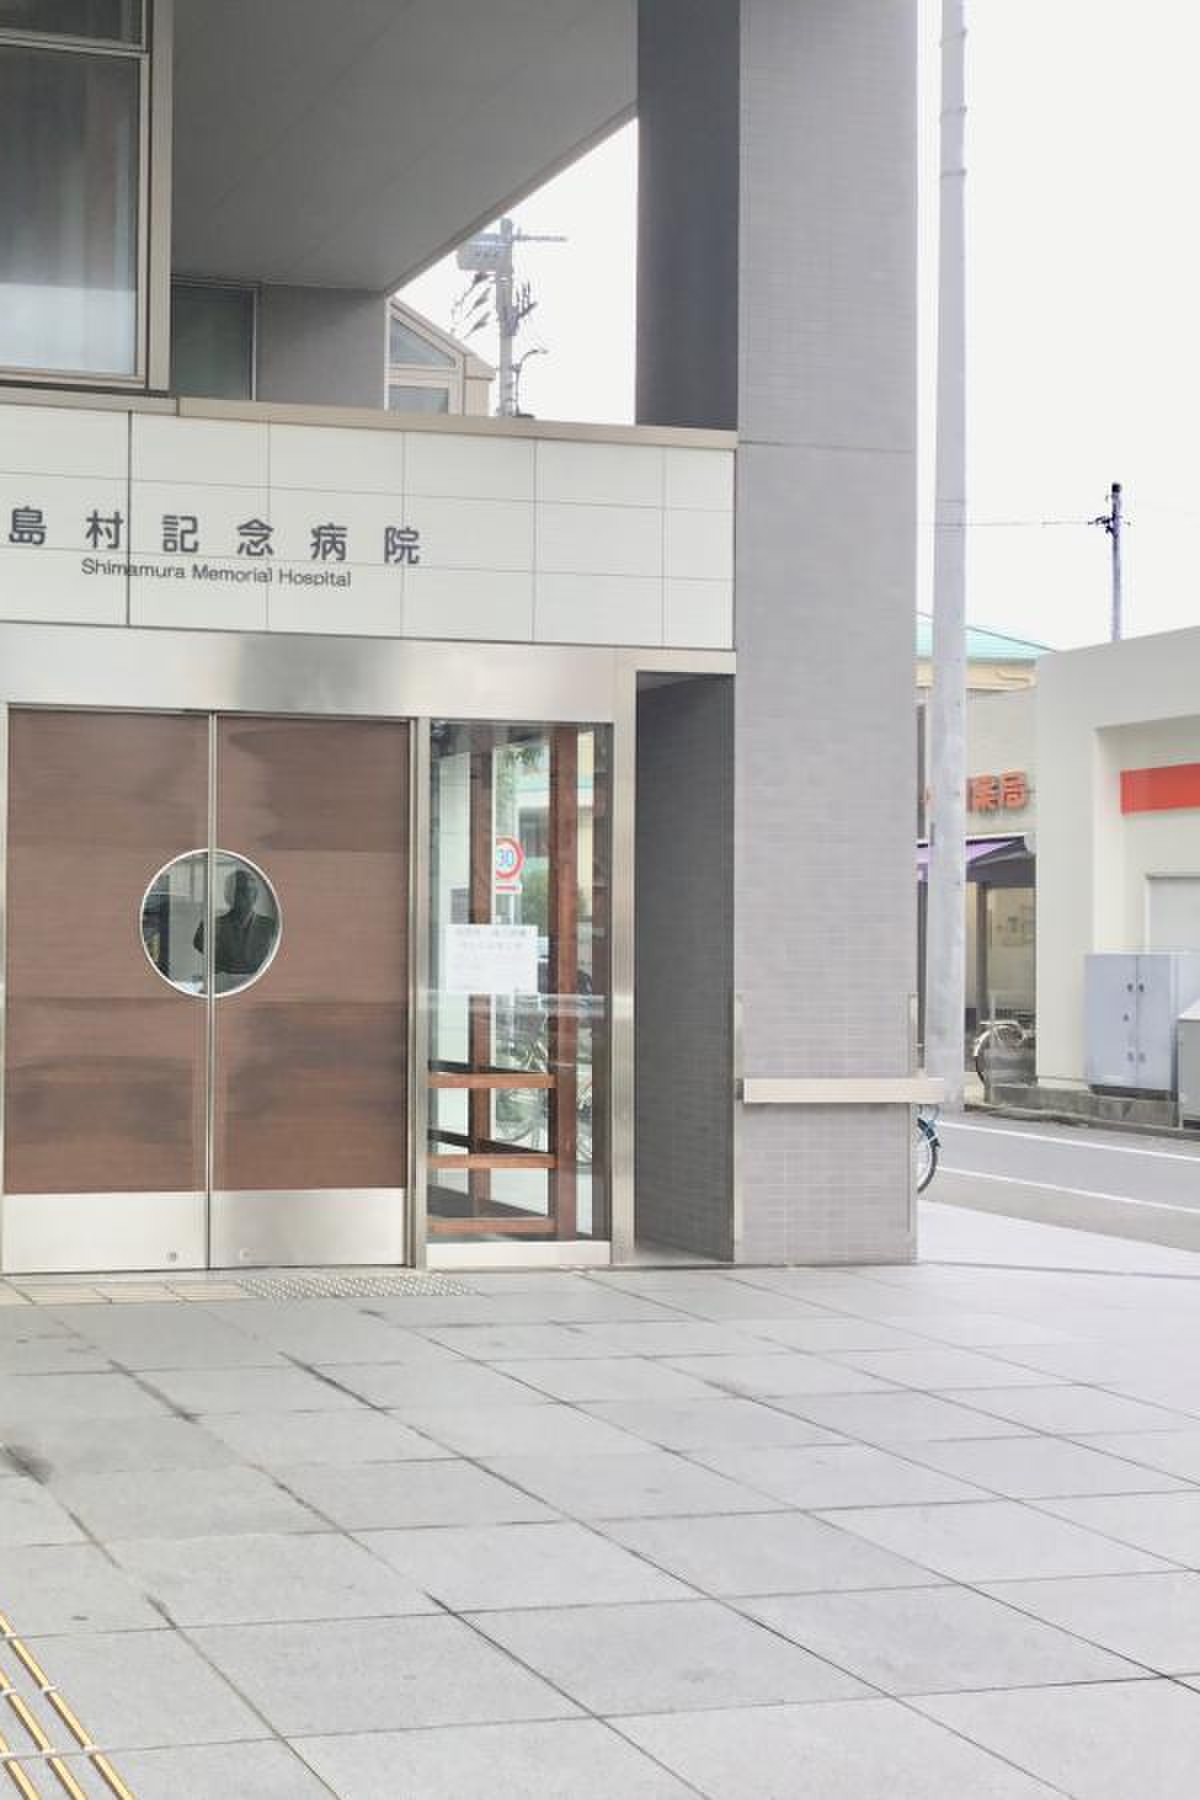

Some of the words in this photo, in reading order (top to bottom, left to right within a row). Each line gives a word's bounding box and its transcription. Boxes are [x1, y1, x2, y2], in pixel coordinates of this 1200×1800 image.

[8, 505, 420, 565] 島村記念病院
[81, 557, 186, 580] Shimamura
[192, 563, 273, 585] Memorial
[278, 568, 352, 589] Hospital
